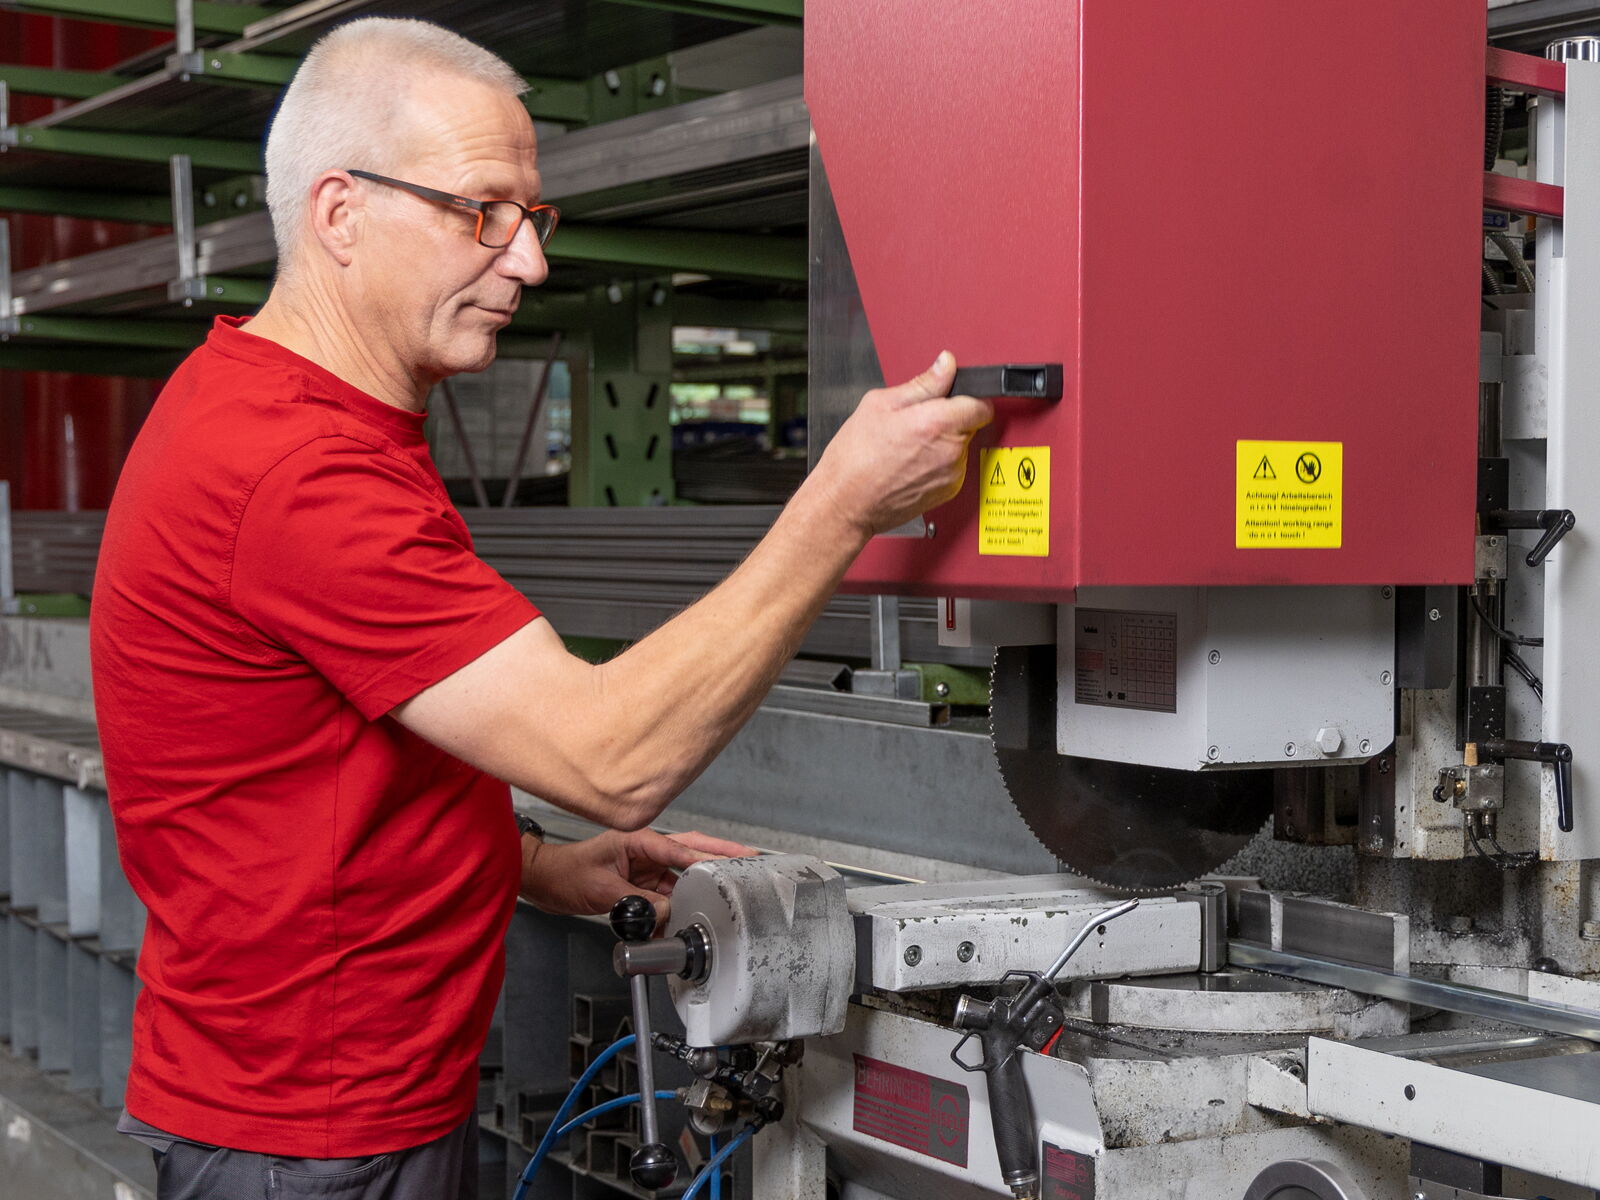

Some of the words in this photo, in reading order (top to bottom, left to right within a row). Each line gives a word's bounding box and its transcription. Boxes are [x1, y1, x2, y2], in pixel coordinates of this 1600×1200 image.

[1246, 491, 1279, 500] Achtung!
[1281, 491, 1333, 500] Arbeitsbereich
[1245, 520, 1281, 528] Attention!
[1282, 520, 1312, 529] working
[857, 1062, 929, 1107] BEHRINGER
[931, 1107, 967, 1133] EISELE
